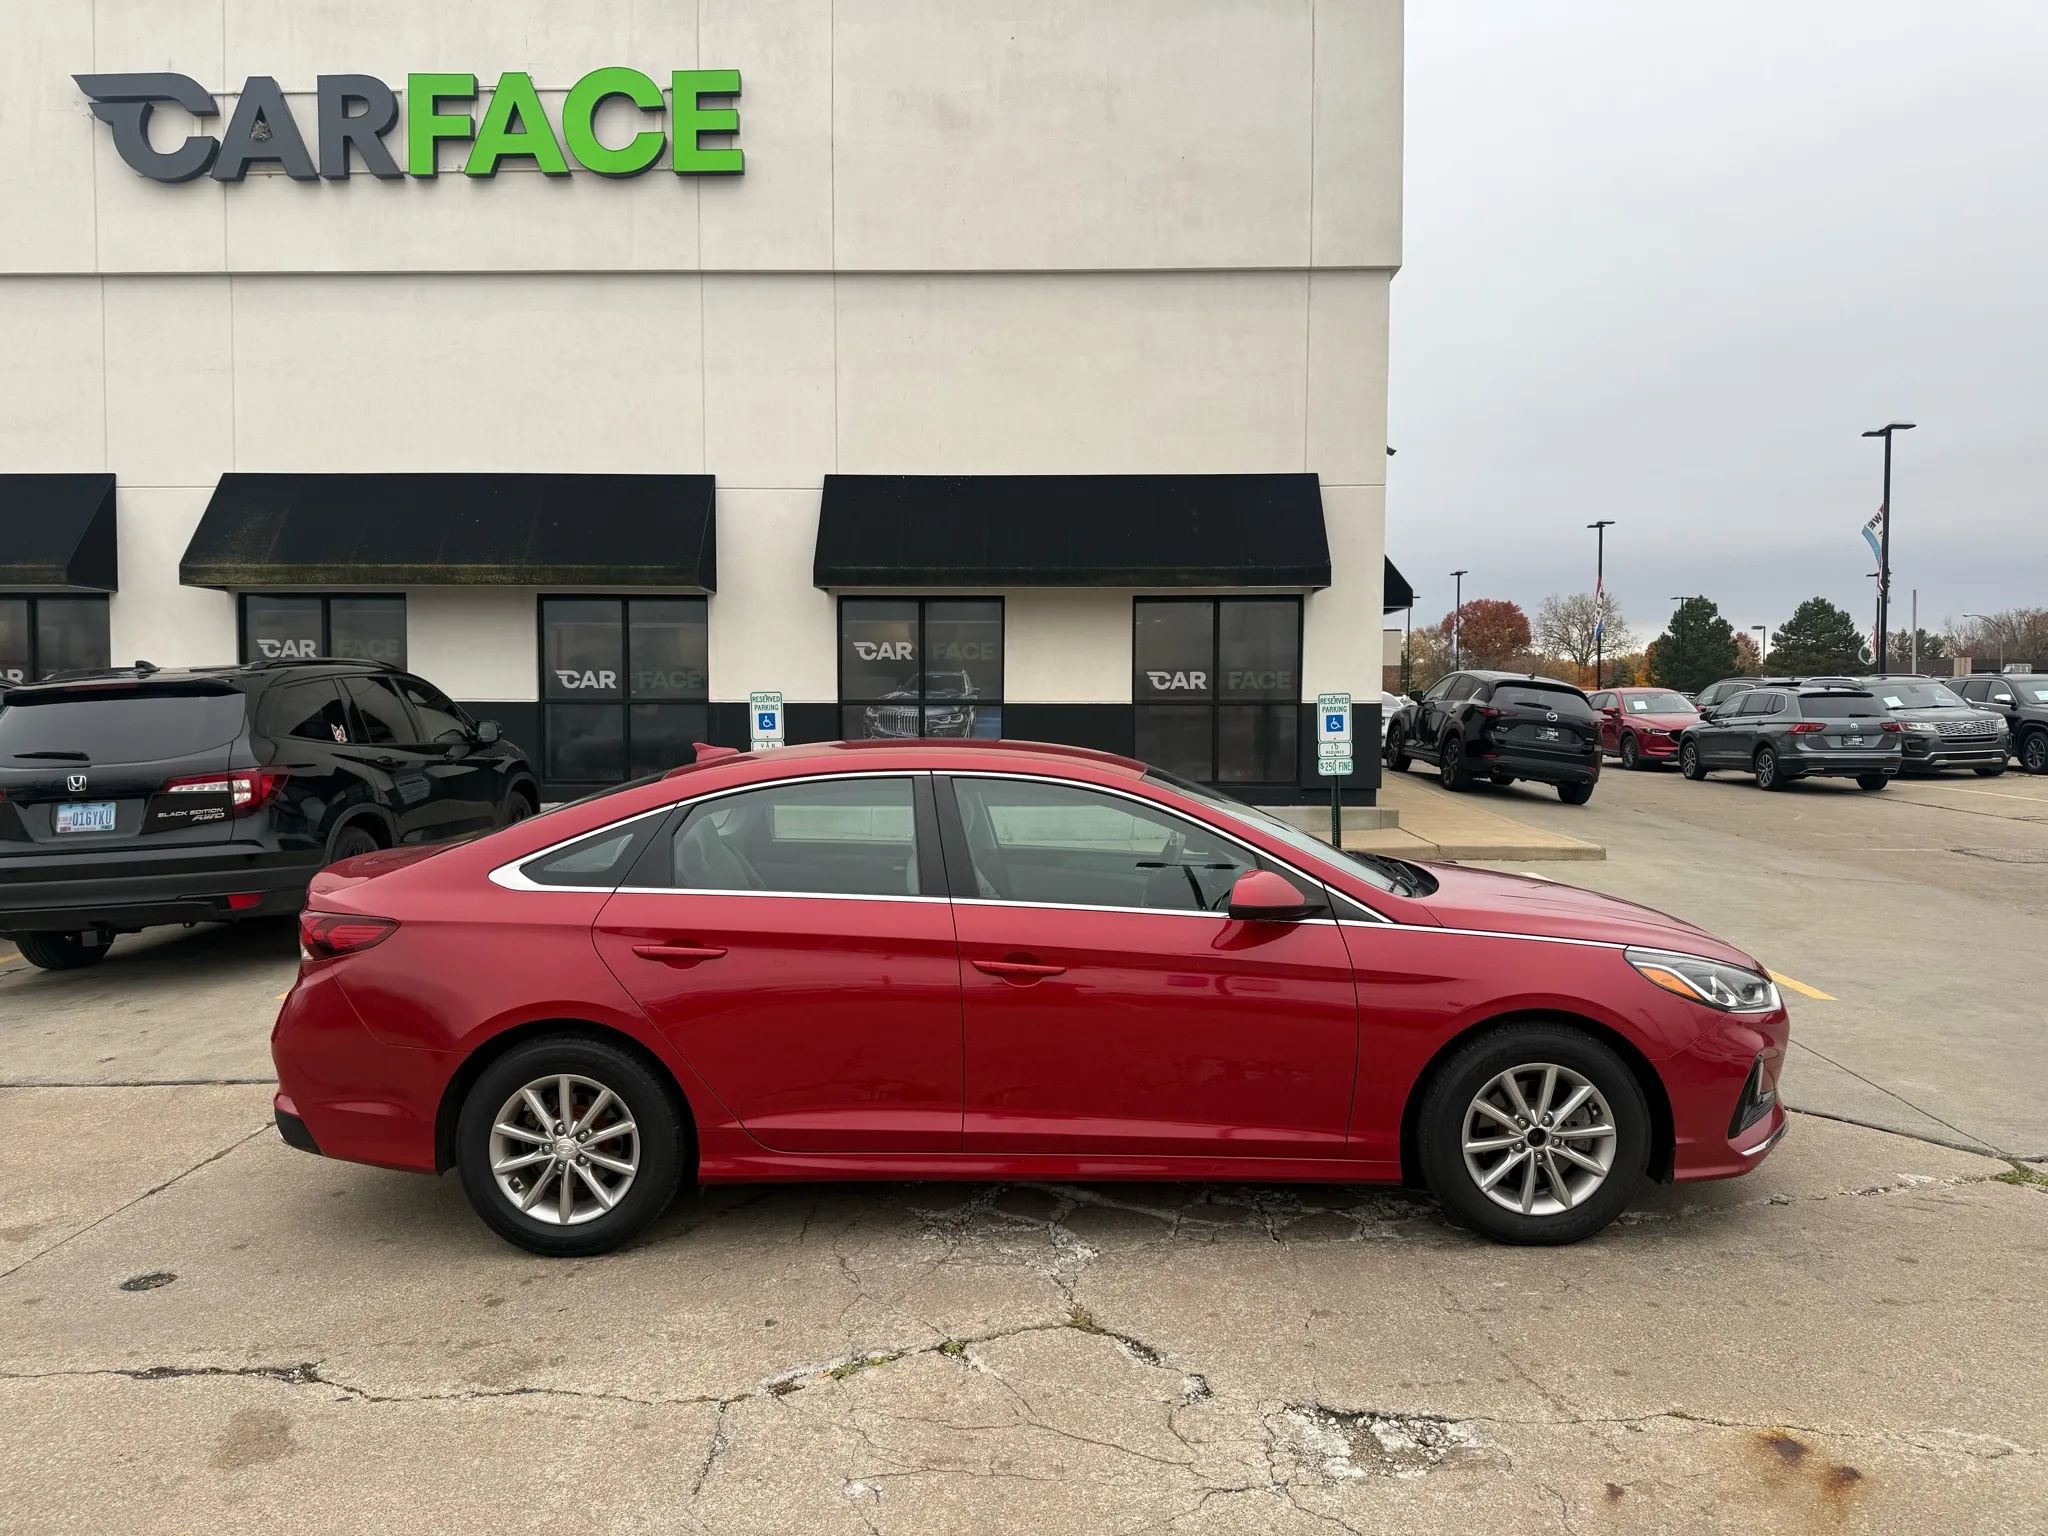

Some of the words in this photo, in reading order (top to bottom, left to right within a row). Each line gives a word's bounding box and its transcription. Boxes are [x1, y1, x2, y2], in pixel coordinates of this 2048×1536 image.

[256, 639, 316, 658] CAR
[337, 639, 400, 657] FACE
[854, 641, 913, 661] CAR
[931, 641, 995, 661] FACE
[555, 670, 617, 689] CAR
[638, 670, 701, 689] FACE
[1146, 671, 1208, 690] CAR
[1228, 671, 1291, 690] FACE
[752, 695, 780, 703] RESERVED
[1320, 697, 1349, 705] RESERVED
[1338, 761, 1352, 771] FINE
[72, 810, 112, 827] 016YKU
[192, 812, 225, 821] AWD
